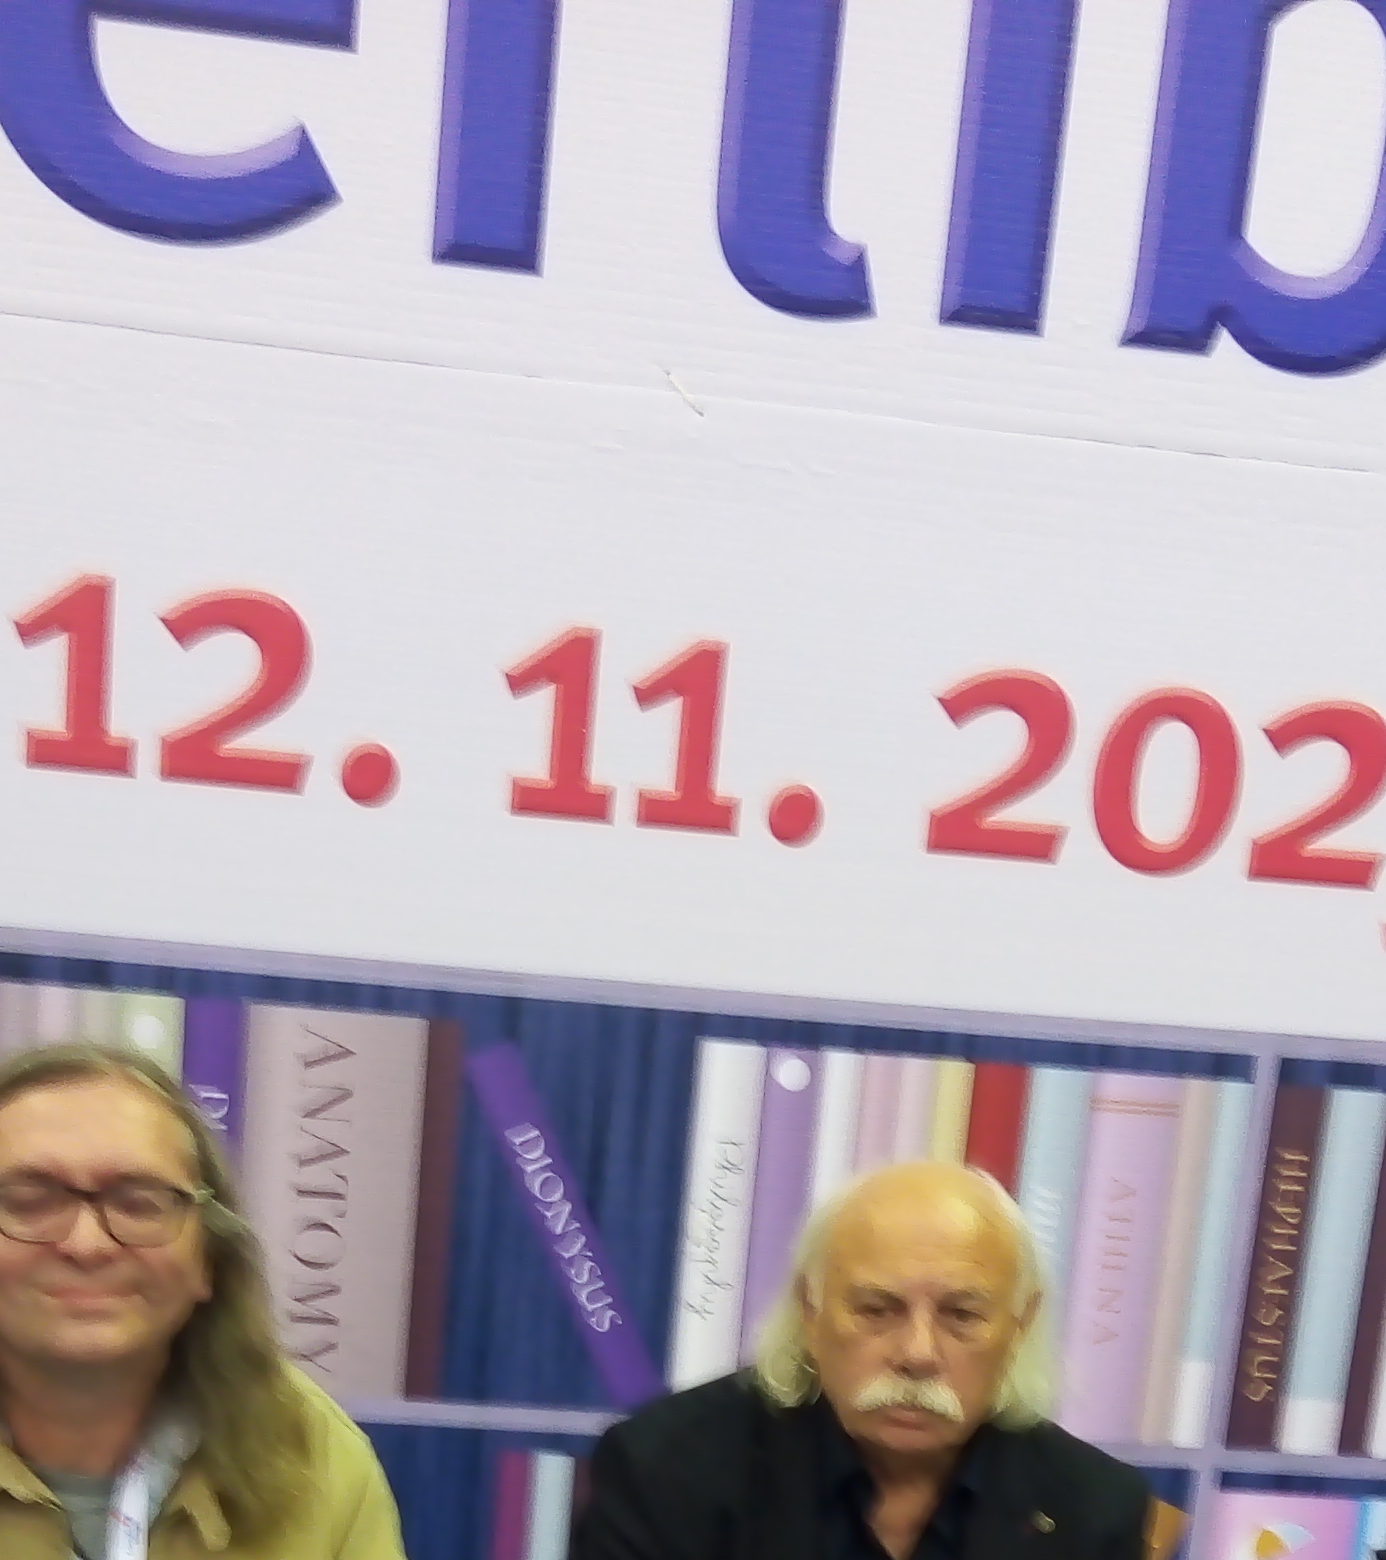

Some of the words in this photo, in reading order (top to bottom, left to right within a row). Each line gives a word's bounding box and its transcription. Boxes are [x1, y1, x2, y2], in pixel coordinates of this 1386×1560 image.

[13, 570, 402, 811] 12.
[502, 624, 825, 849] 11.
[287, 1023, 358, 1374] ANATOMY
[503, 1121, 623, 1334] DIONYSUS
